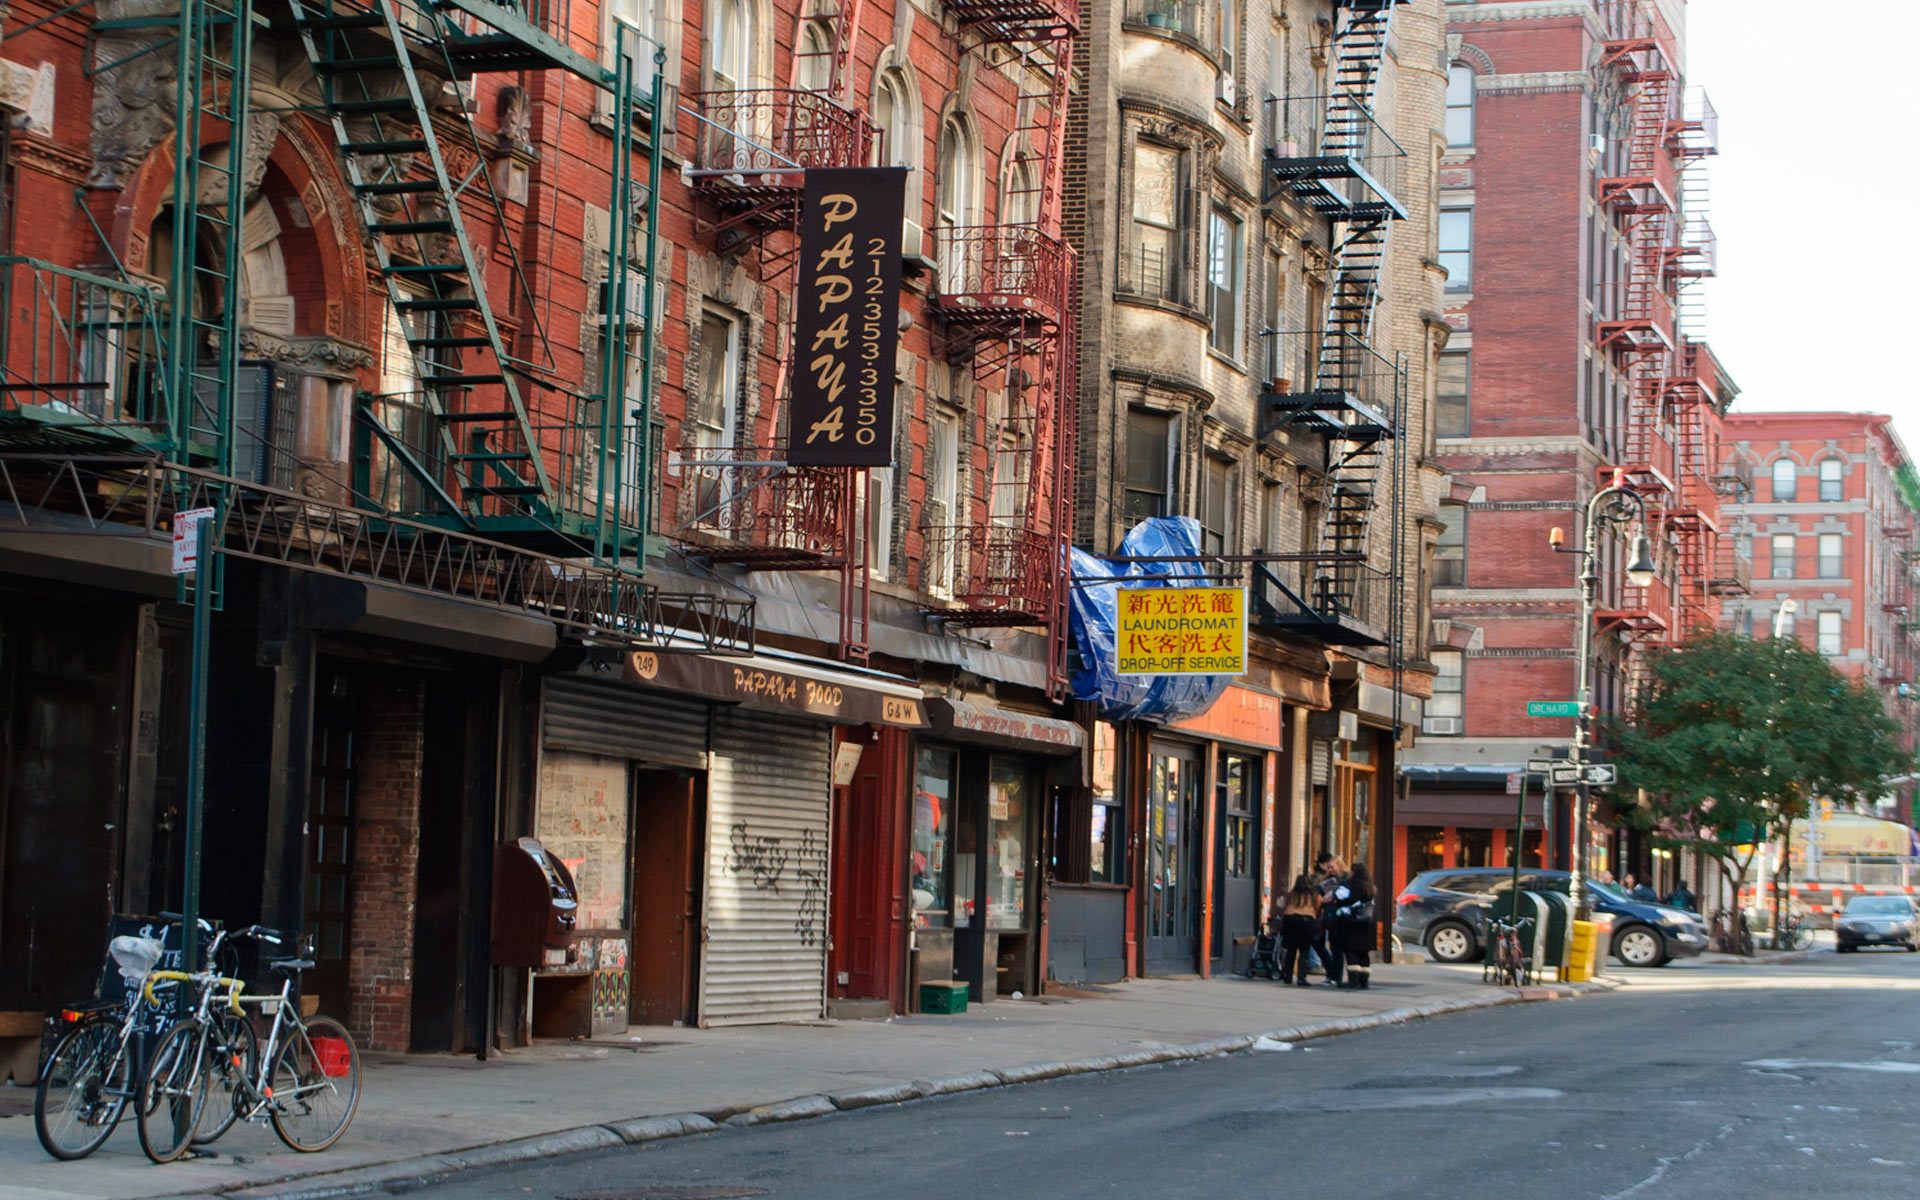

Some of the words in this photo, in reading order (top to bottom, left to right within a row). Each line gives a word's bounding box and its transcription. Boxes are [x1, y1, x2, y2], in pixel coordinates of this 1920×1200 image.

[806, 194, 857, 444] PAPAYA
[1123, 617, 1237, 631] LAUNDROMAT
[1127, 633, 1233, 654] 代客洗衣
[637, 655, 653, 673] 249
[1120, 657, 1185, 670] DROP-OFF
[1189, 656, 1240, 669] SERVICE
[733, 668, 797, 703] PAPAYA
[806, 681, 843, 707] FOOD
[1530, 703, 1569, 714] ORCHARD
